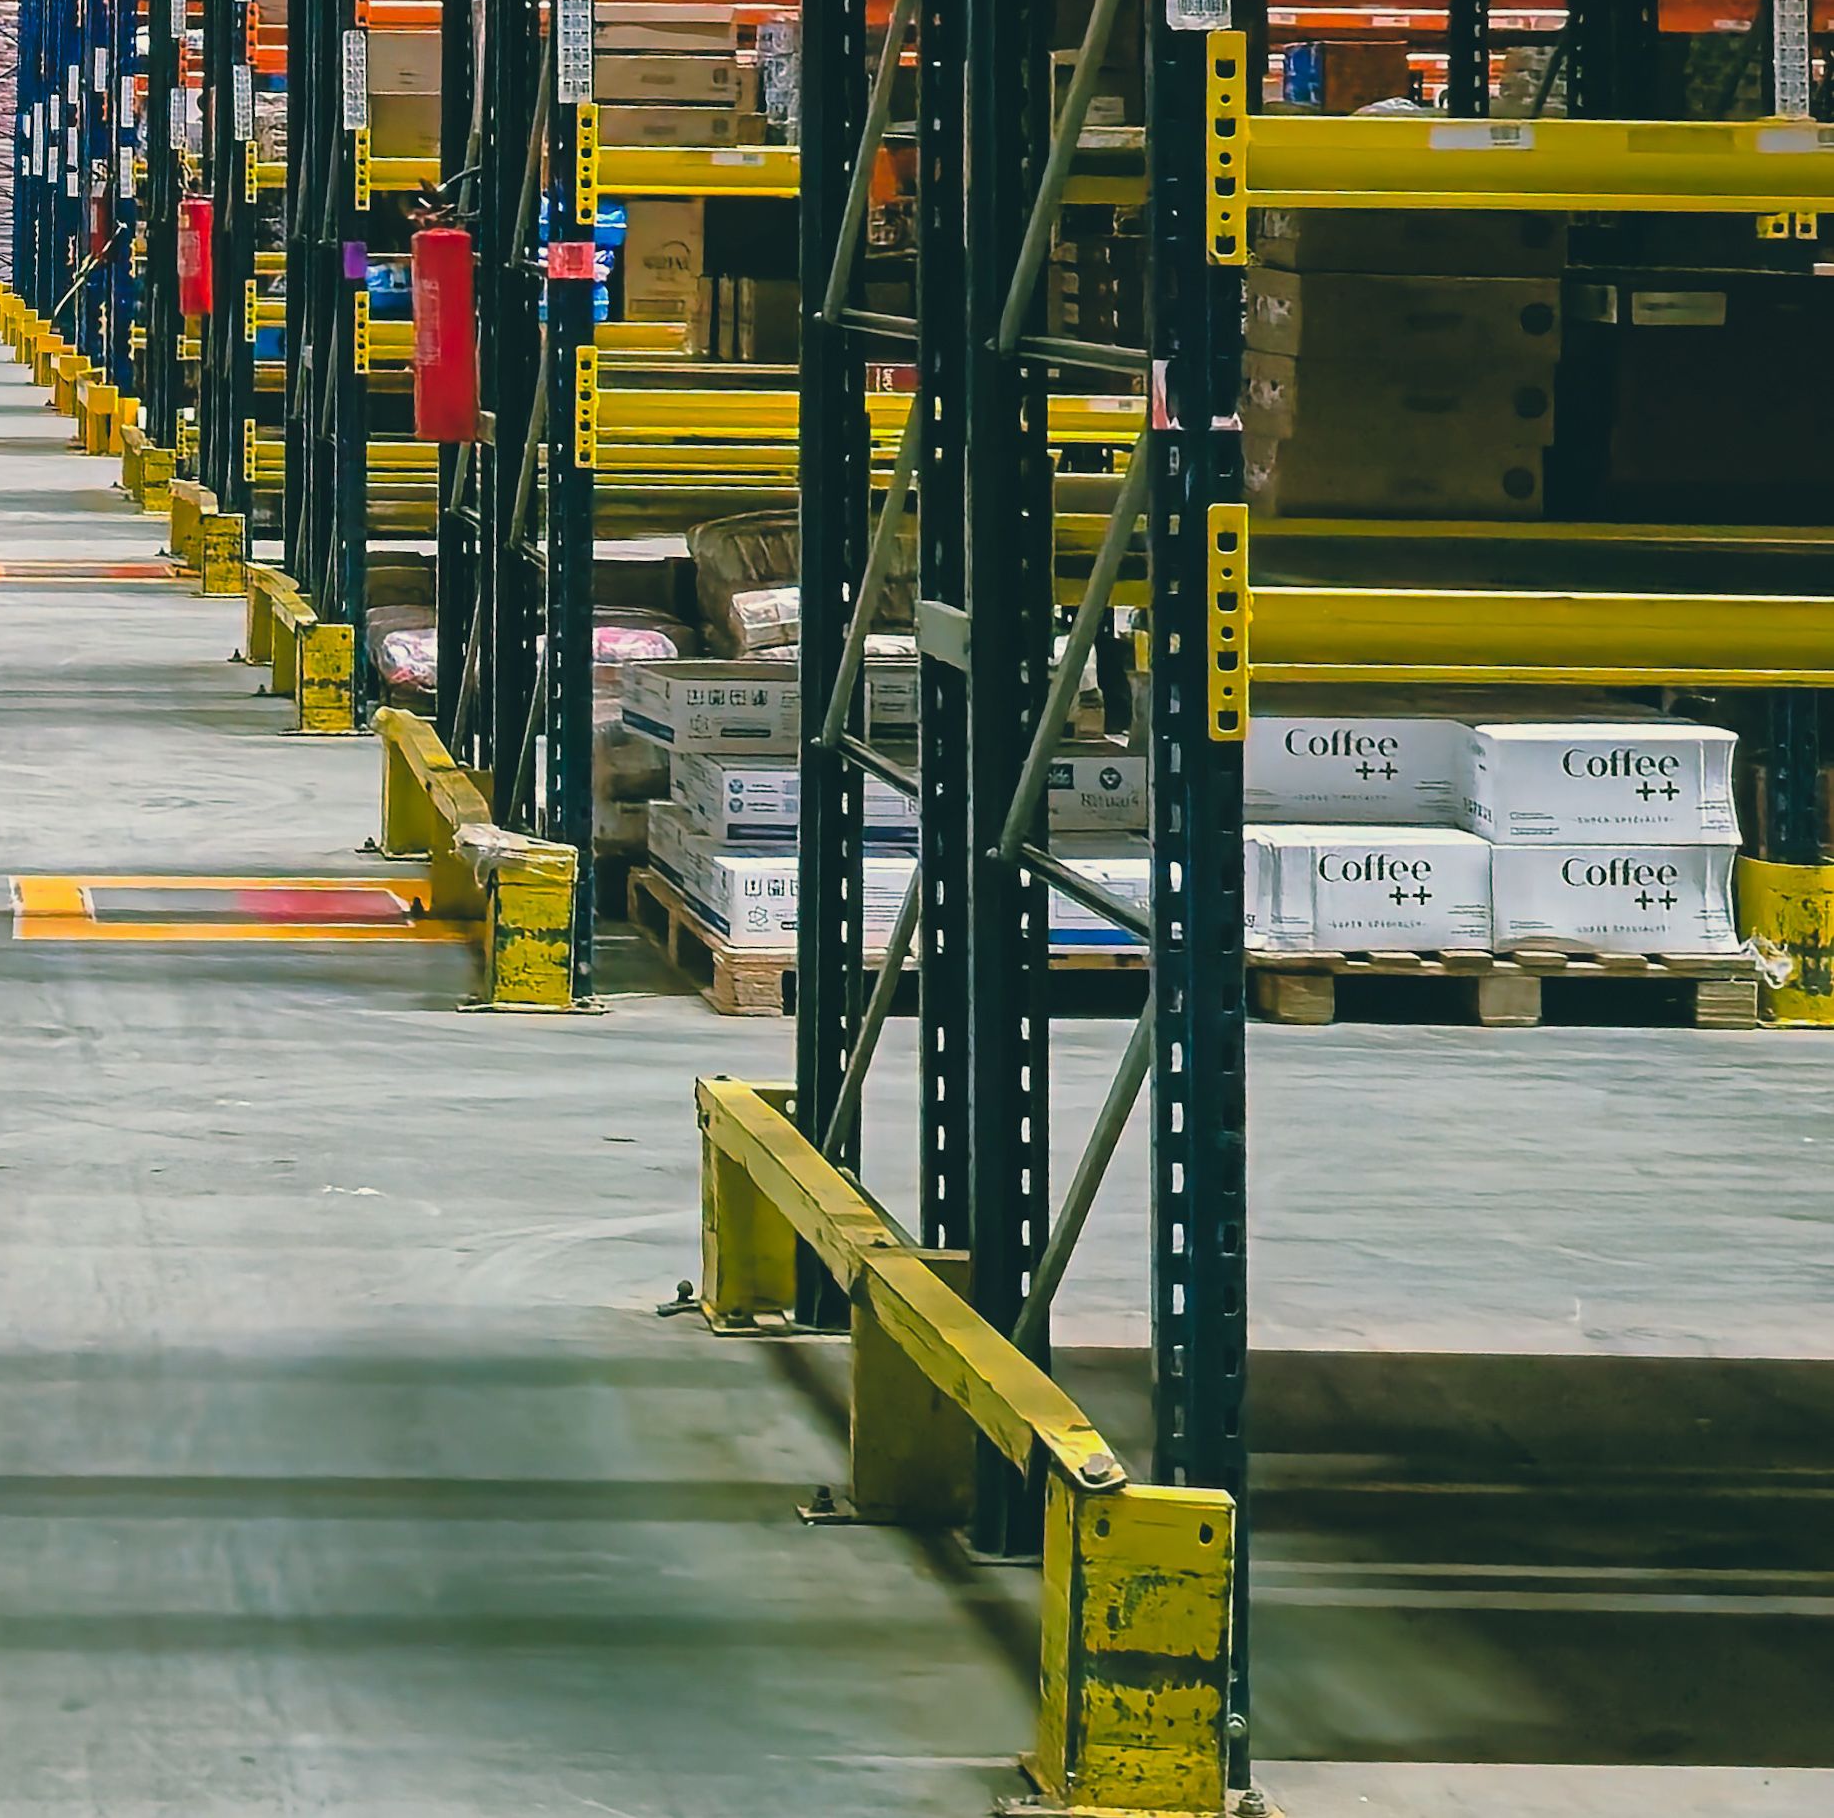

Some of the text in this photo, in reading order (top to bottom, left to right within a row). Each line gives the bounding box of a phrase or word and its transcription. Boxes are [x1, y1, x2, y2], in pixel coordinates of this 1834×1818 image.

[1284, 728, 1399, 757] Coffee
[1562, 748, 1680, 778] Coffee
[1318, 853, 1432, 882] Coffee
[1561, 857, 1678, 887] Coffee
